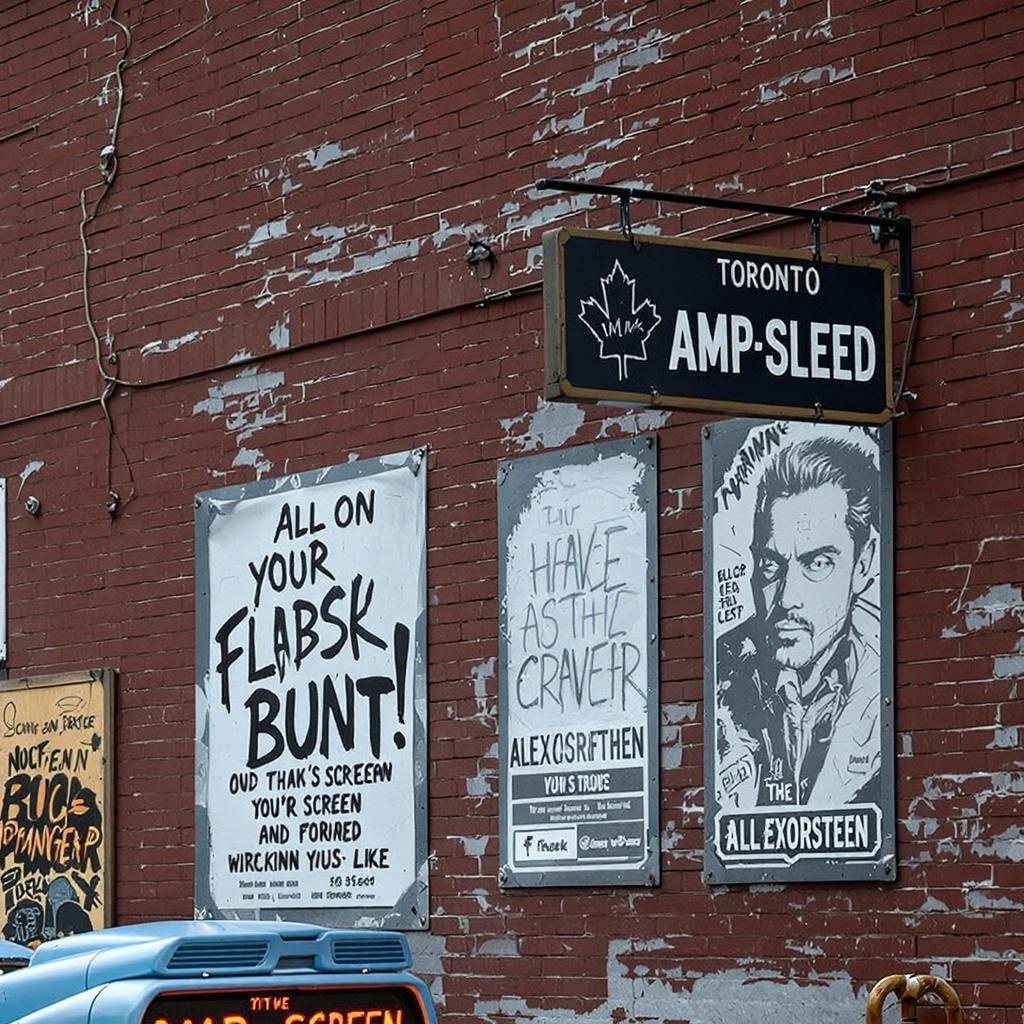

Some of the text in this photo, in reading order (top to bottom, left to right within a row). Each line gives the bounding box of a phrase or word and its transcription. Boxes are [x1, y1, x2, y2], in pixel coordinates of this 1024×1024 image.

[717, 258, 821, 295] TORONTO
[273, 489, 375, 543] ALL ON
[248, 539, 336, 610] YOUR
[214, 573, 388, 714] FLABSK
[266, 764, 320, 791] THAK'S
[766, 782, 793, 801] THE
[251, 793, 362, 819] YOU'R SCREEN
[259, 824, 290, 845] AND
[353, 848, 390, 869] LIKE
